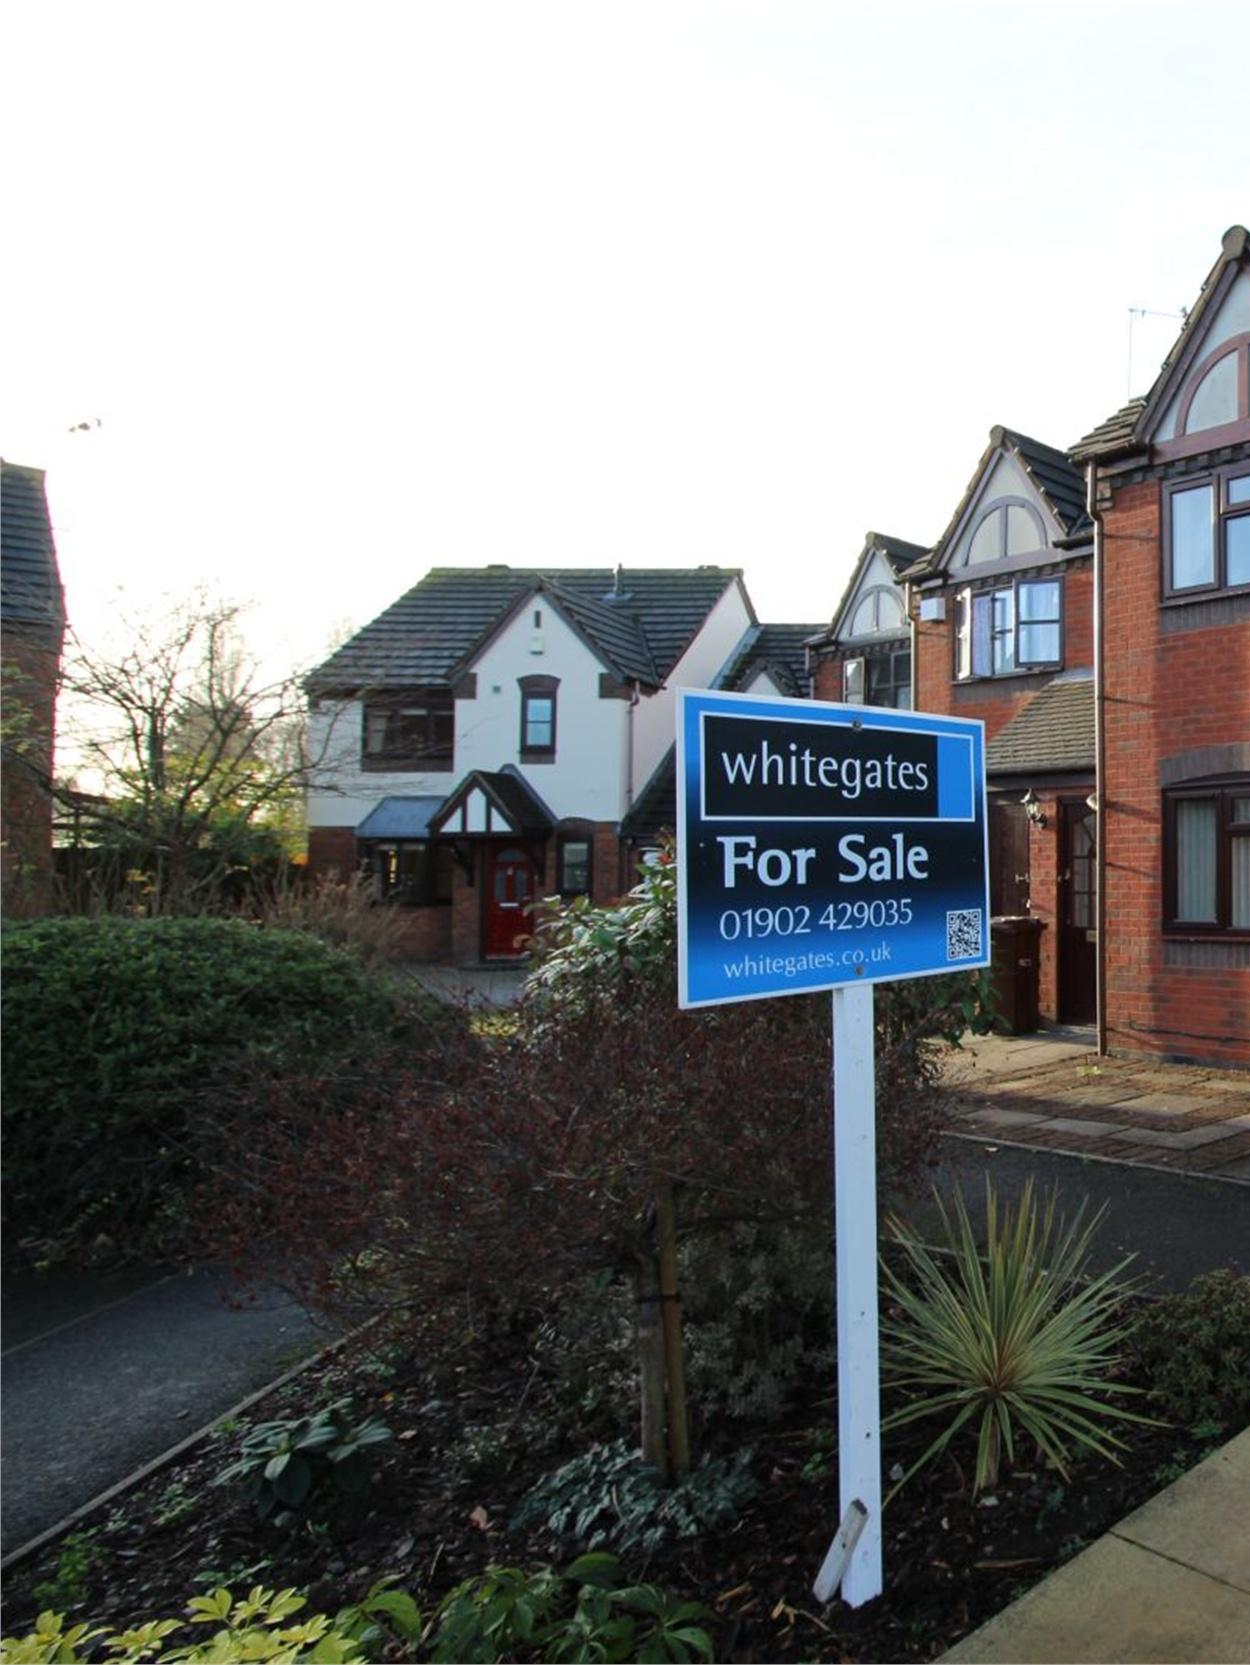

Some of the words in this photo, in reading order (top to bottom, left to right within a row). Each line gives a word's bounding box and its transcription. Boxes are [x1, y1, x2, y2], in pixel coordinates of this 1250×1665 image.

[721, 740, 928, 799] whitegates
[716, 835, 816, 888] For
[838, 833, 929, 882] Sale
[719, 905, 811, 940] 01902
[819, 898, 913, 931] 429035
[723, 941, 892, 978] whitegates.co.uk
